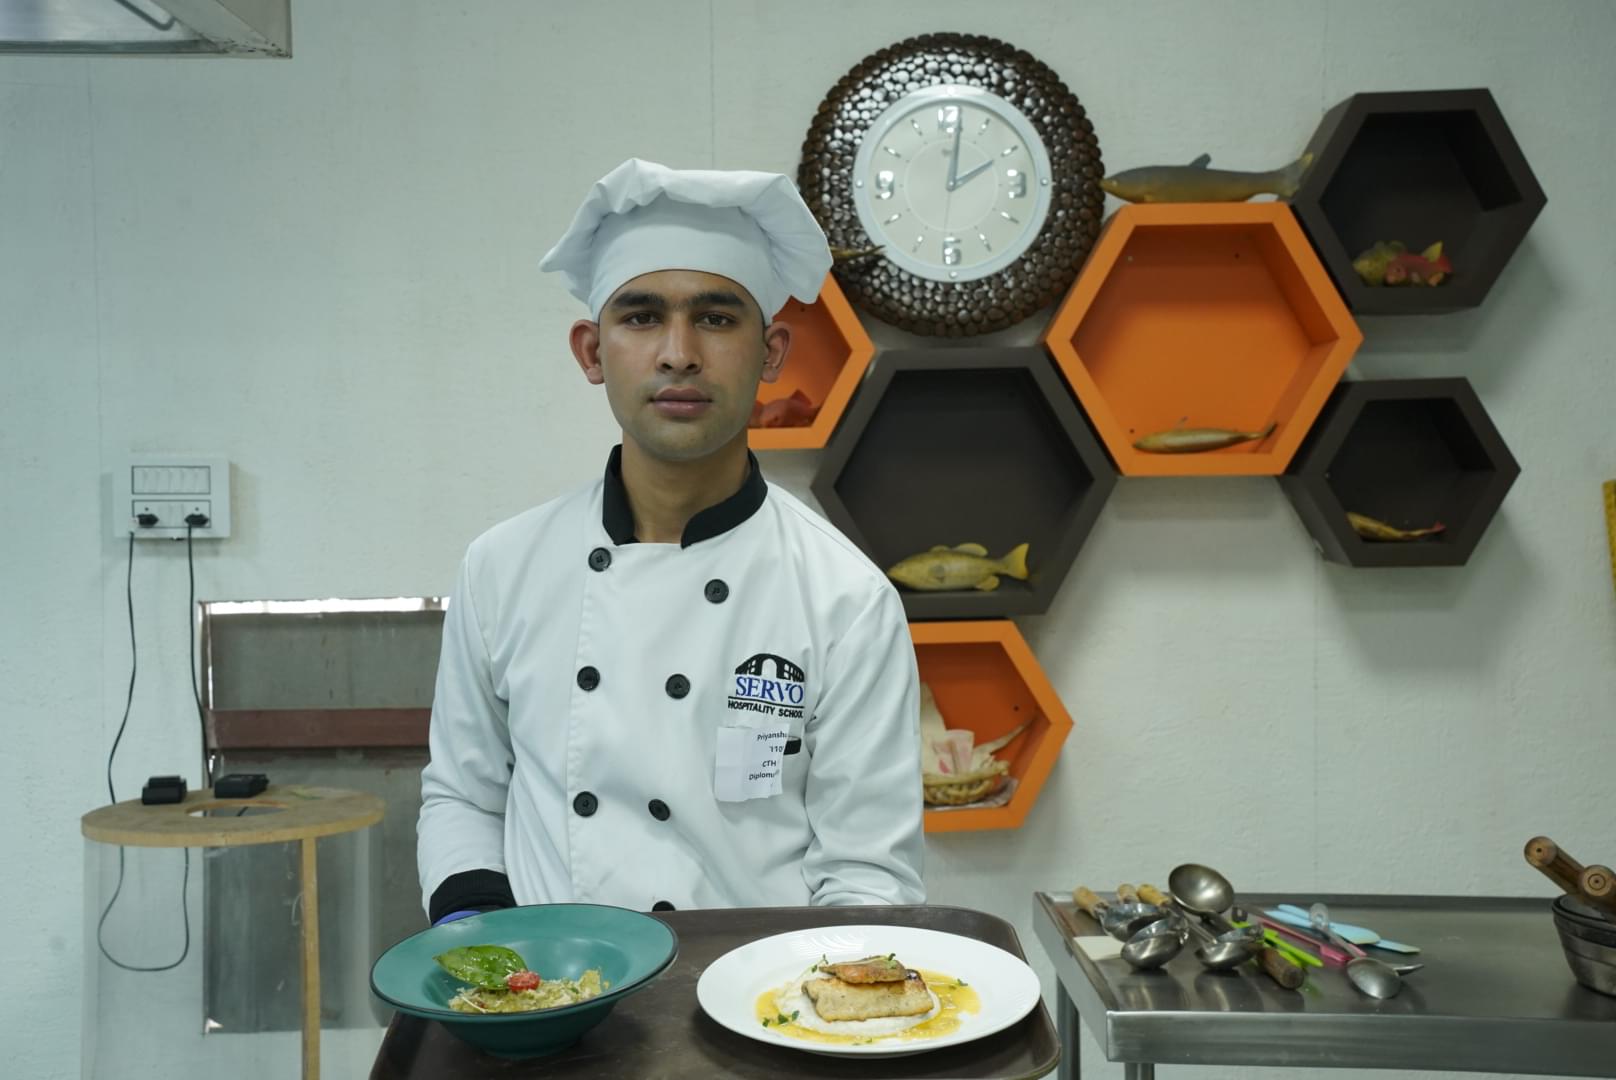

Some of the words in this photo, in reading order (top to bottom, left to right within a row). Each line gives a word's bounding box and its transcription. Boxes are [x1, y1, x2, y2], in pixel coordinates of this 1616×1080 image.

[876, 170, 894, 200] 9
[1007, 169, 1026, 199] 3
[943, 236, 962, 266] 6
[735, 676, 804, 704] SERVO
[727, 700, 776, 715] HOSPITALITY
